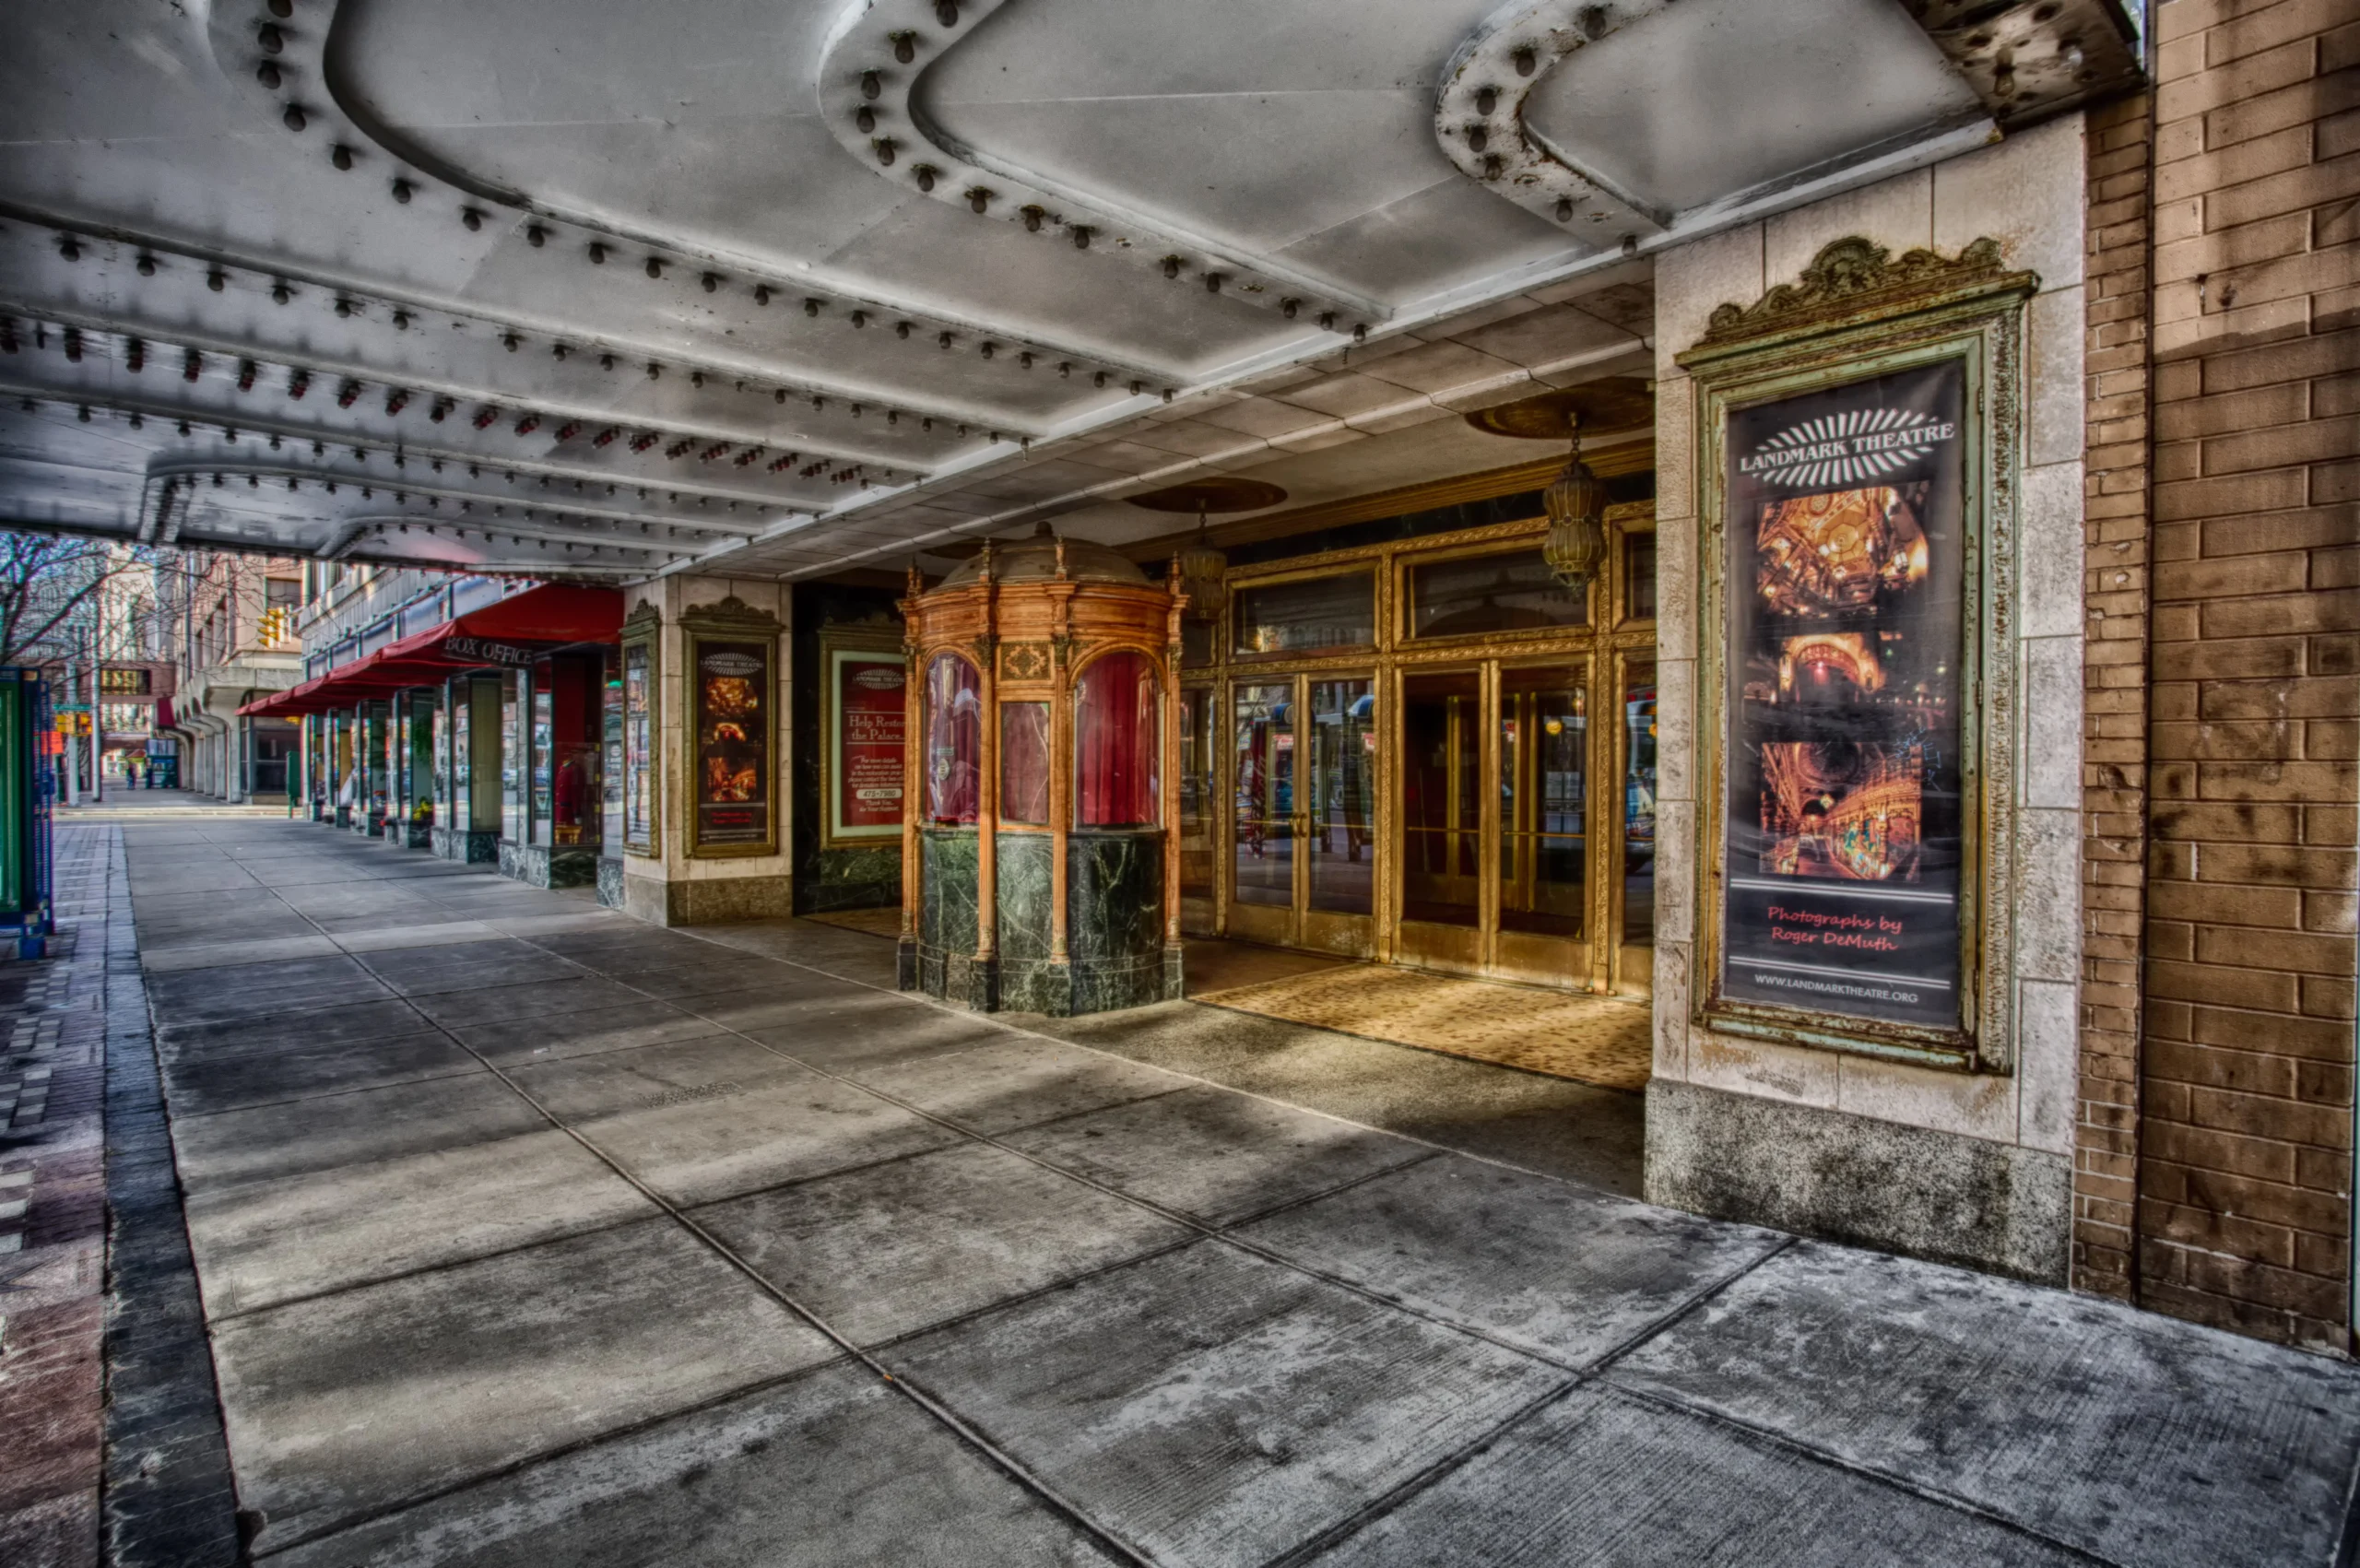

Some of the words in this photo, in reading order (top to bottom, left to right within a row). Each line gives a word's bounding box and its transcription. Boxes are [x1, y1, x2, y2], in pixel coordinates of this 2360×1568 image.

[1740, 440, 1848, 473] LANDMARK
[1851, 421, 1955, 454] THEATRE
[443, 636, 479, 655] BOX
[482, 643, 533, 665] OFFICE
[848, 715, 874, 729] Help
[875, 715, 905, 727] Restor
[851, 728, 867, 740] the
[1767, 906, 1876, 929] Photographs
[1879, 915, 1903, 935] by
[1771, 926, 1819, 945] Roger
[1823, 932, 1898, 951] DeMuth
[1754, 973, 1918, 1004] WWW.LANDMARKTHEATRE.ORG
